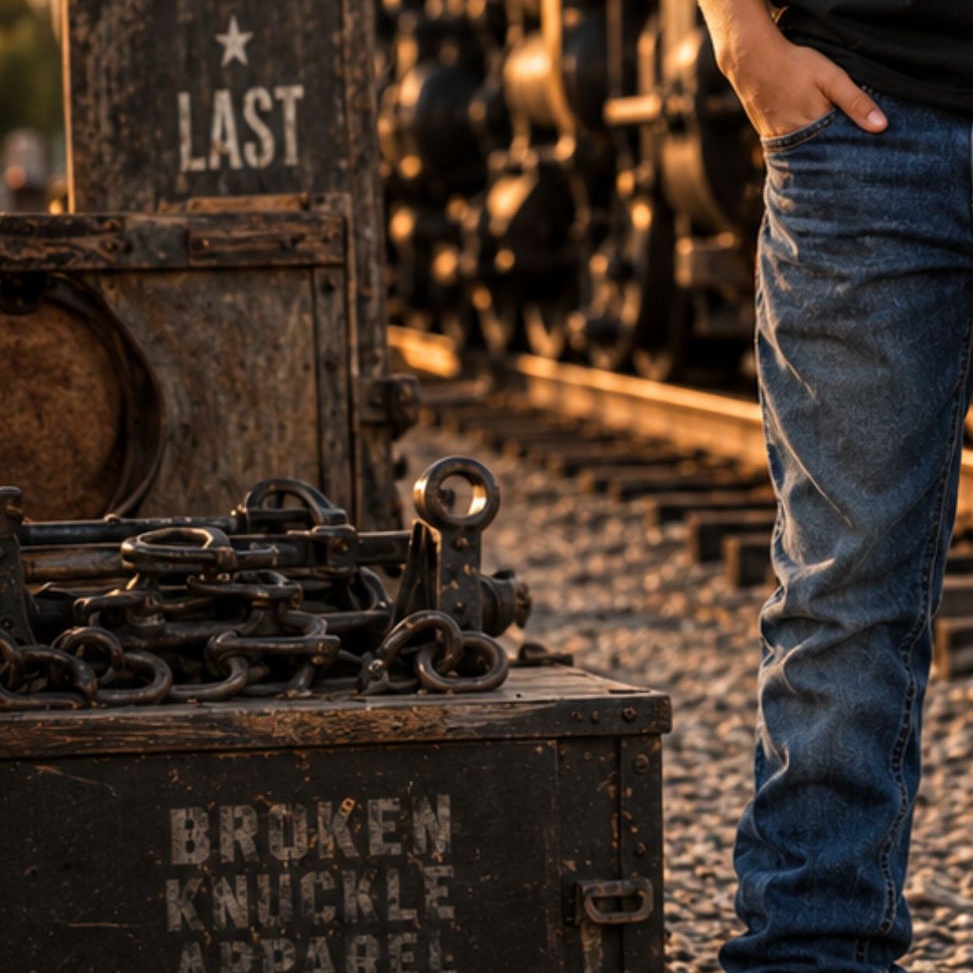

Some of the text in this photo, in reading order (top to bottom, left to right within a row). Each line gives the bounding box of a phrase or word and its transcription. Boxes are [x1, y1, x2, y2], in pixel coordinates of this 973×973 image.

[178, 84, 305, 172] LAST
[169, 793, 453, 865] BROKEN
[165, 865, 455, 932] KNUCKLE
